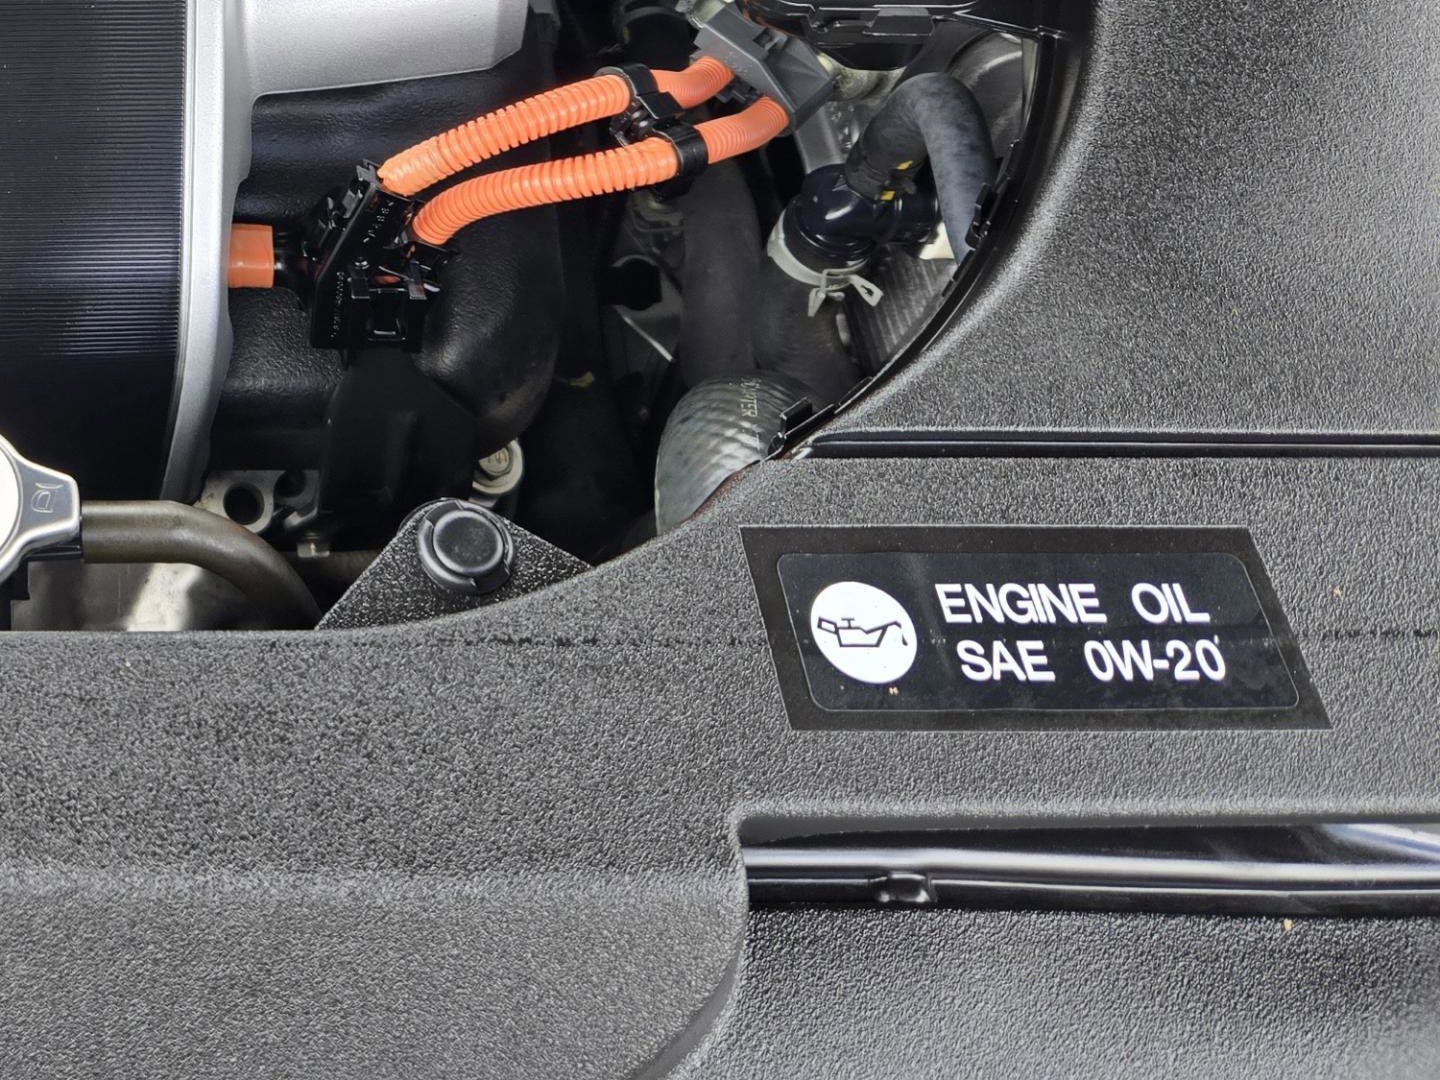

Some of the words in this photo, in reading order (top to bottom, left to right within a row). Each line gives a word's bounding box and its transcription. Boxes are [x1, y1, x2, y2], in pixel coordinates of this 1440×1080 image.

[935, 583, 1107, 624] ENGINE
[1130, 583, 1210, 623] OIL
[956, 640, 1056, 682] SAE
[1083, 639, 1227, 682] 0W-20
